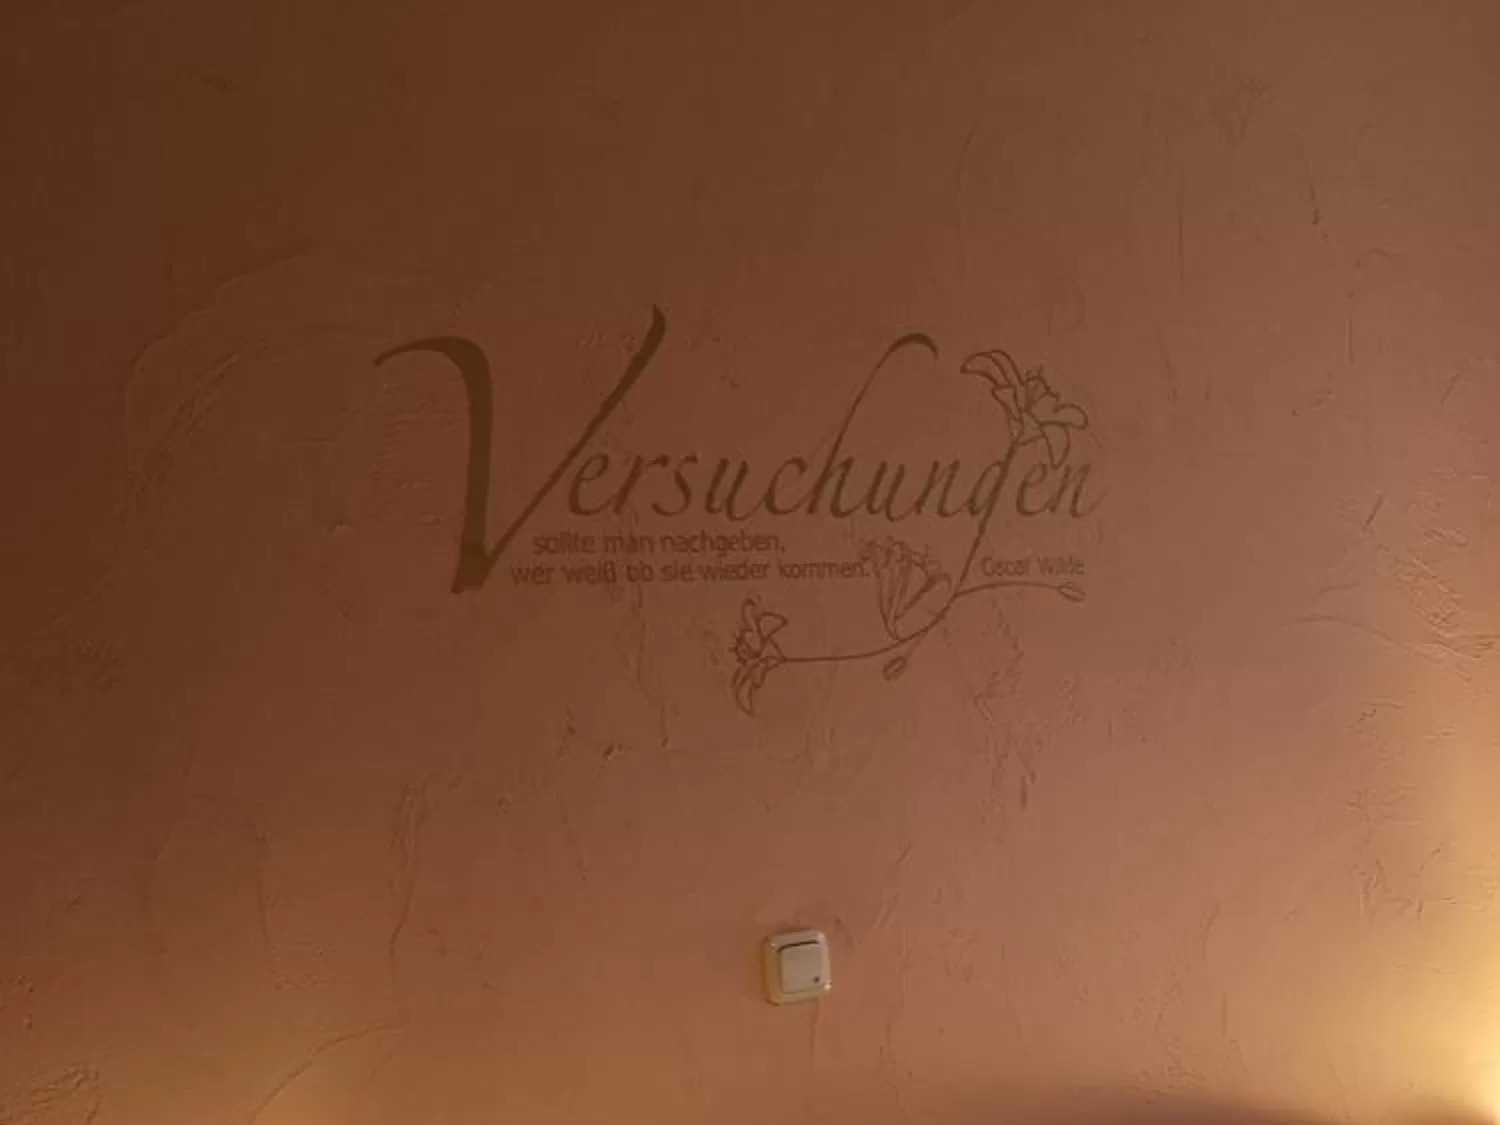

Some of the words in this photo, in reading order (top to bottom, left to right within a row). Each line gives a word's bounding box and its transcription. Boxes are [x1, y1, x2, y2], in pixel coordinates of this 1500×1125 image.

[373, 304, 1100, 594] Versuchungen
[532, 531, 597, 555] sollte
[603, 534, 654, 553] man
[660, 529, 786, 558] nachgeben,
[511, 565, 553, 585] wer
[627, 562, 654, 583] ob
[660, 560, 696, 582] sie
[701, 559, 769, 581] wieder
